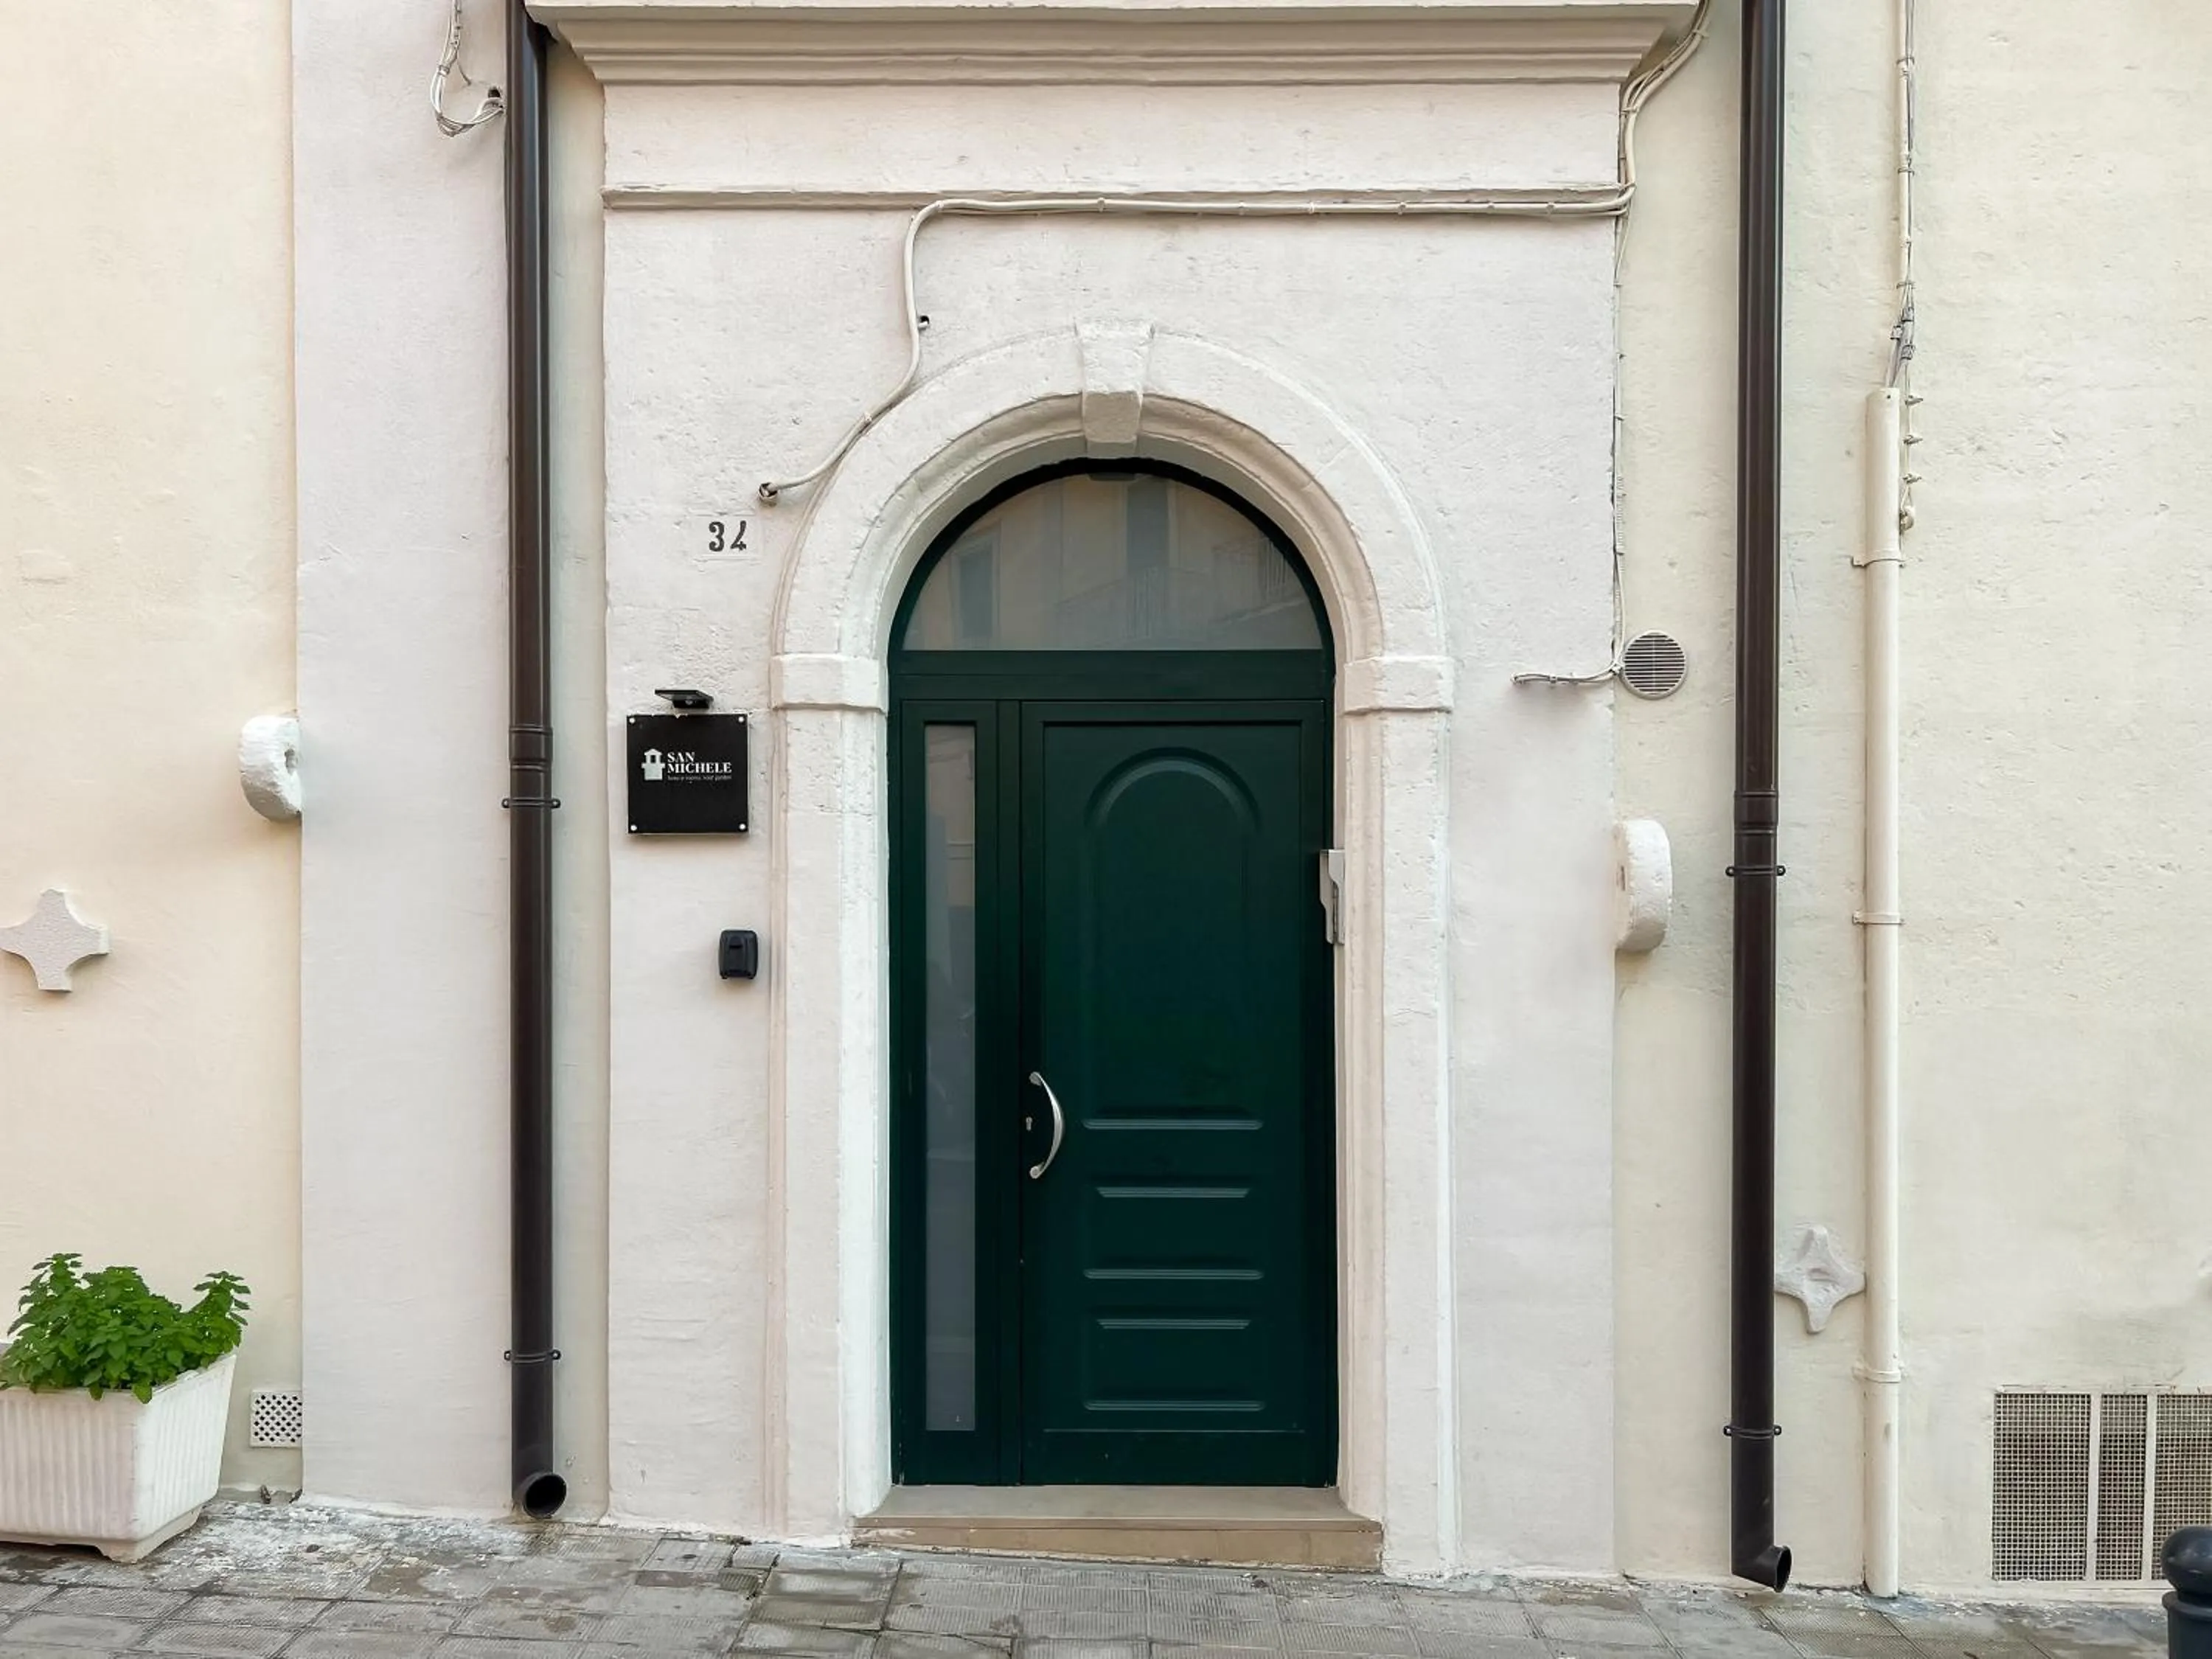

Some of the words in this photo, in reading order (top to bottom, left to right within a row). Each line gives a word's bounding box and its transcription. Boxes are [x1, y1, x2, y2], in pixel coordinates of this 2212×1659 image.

[709, 520, 747, 552] 34
[667, 751, 695, 762] SAN
[667, 762, 732, 773] MICHELE
